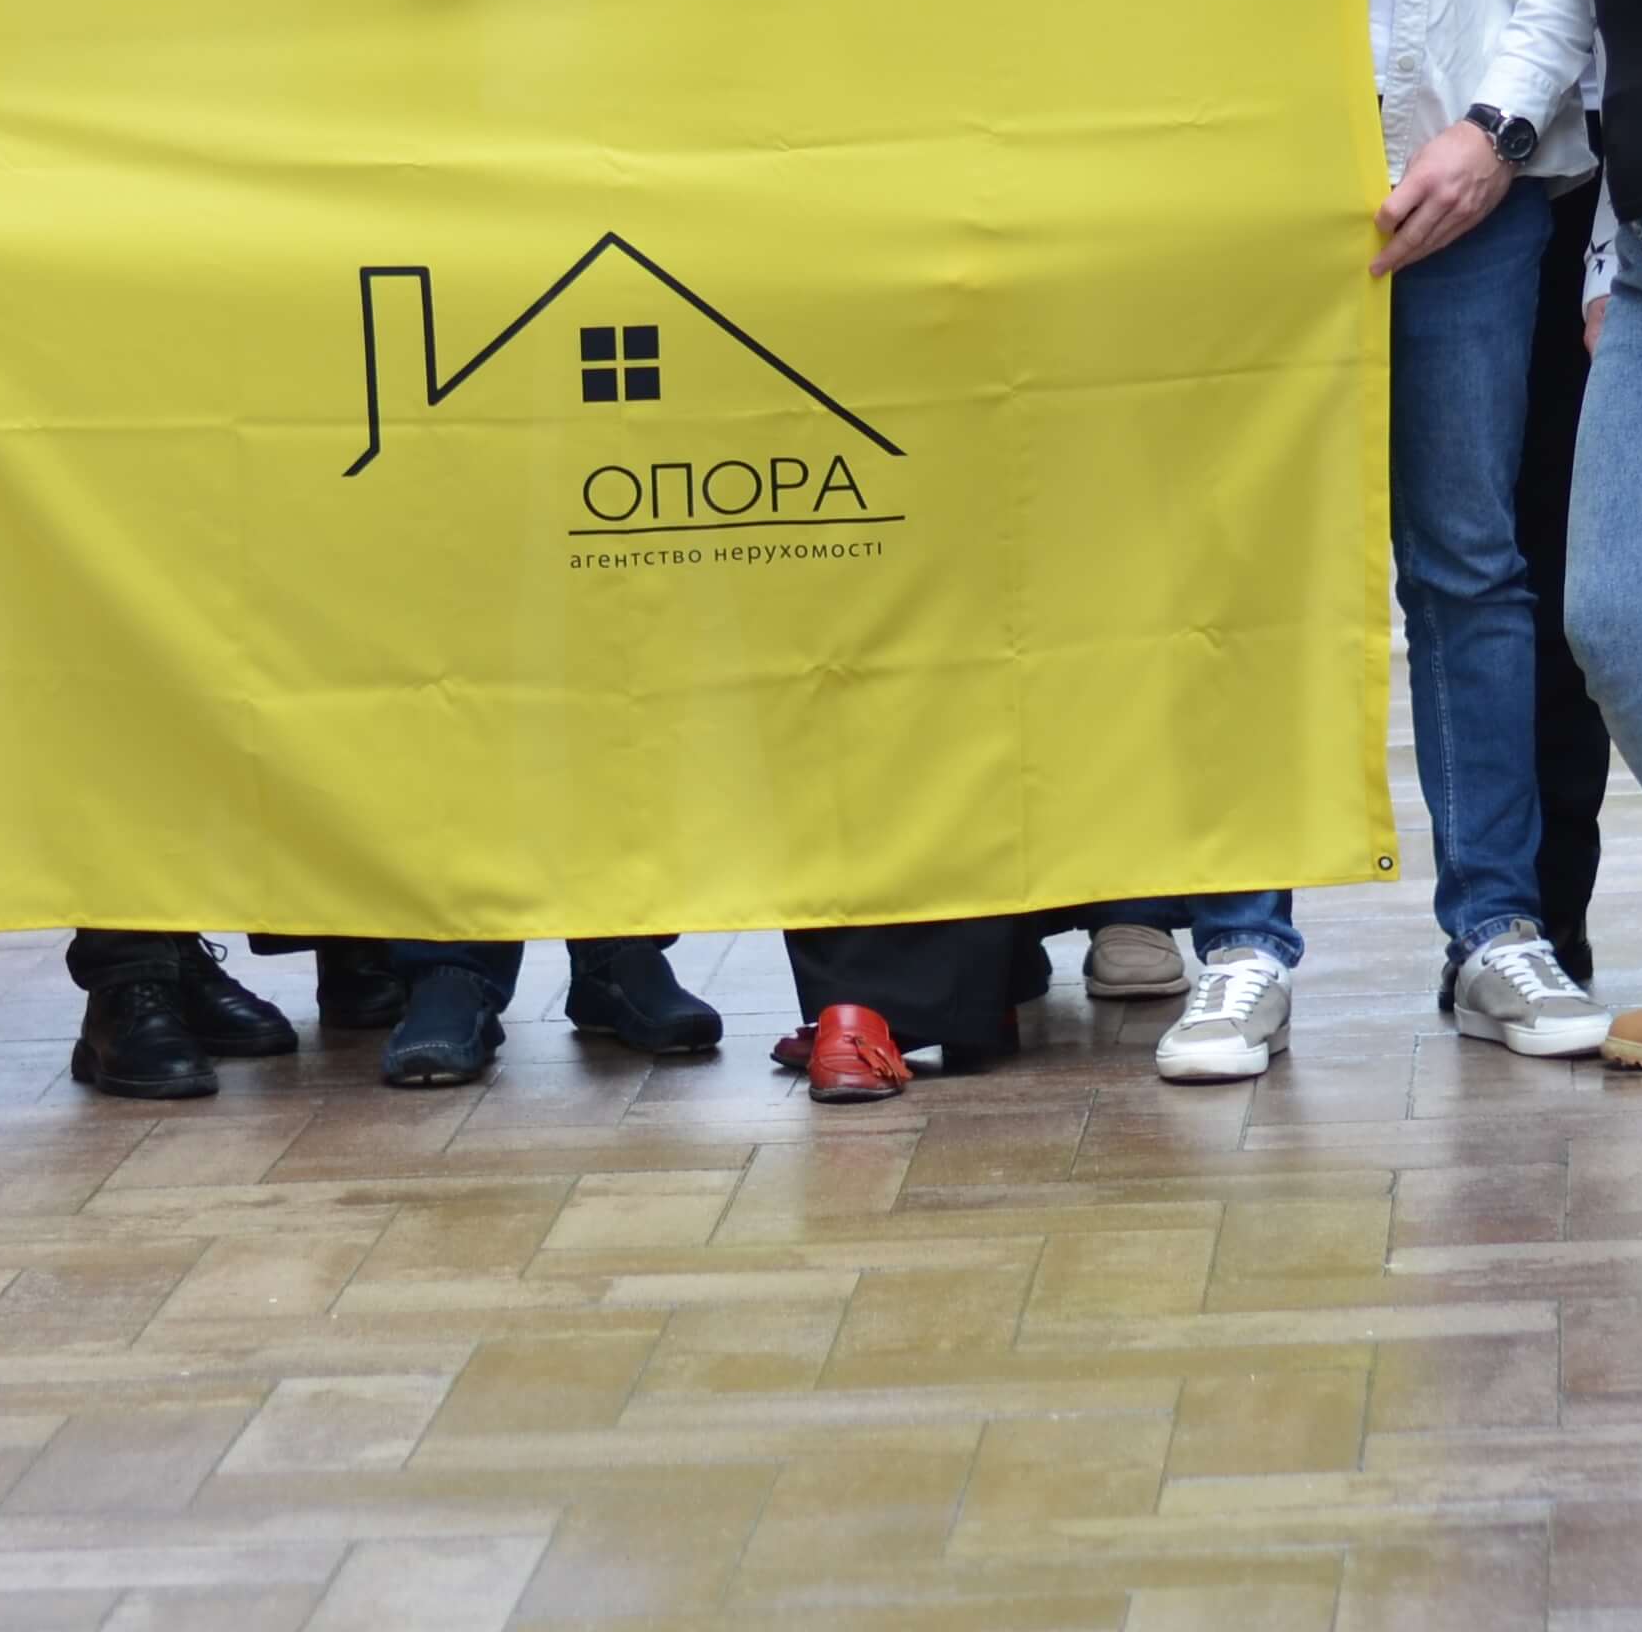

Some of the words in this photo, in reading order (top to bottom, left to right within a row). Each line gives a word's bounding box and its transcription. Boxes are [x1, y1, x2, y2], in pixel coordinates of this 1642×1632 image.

[582, 455, 868, 521] ОПОРА
[570, 549, 702, 569] агентство
[714, 541, 883, 565] нерухомості
